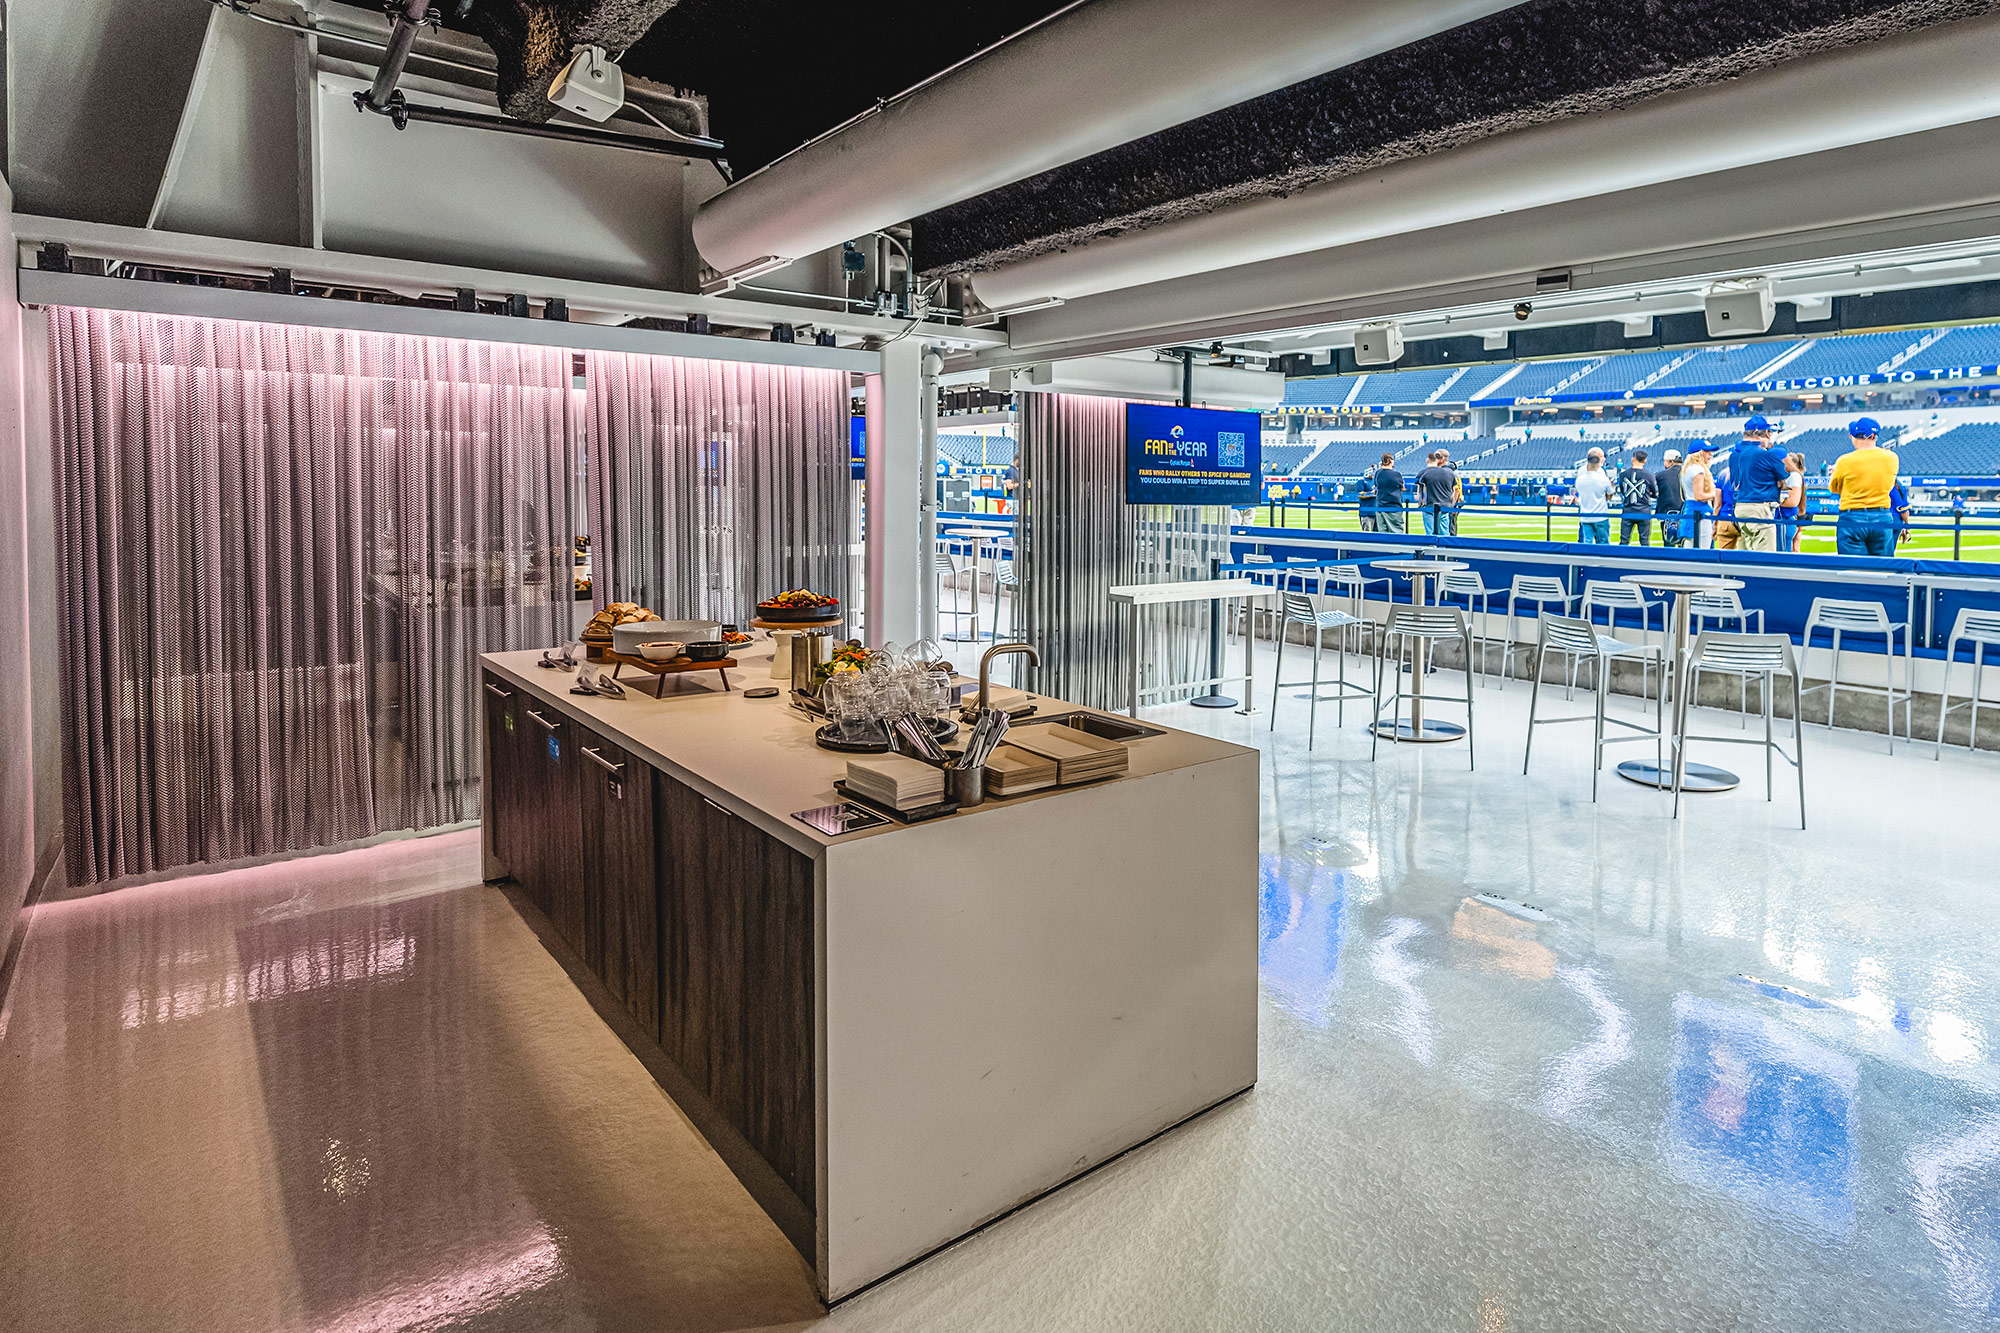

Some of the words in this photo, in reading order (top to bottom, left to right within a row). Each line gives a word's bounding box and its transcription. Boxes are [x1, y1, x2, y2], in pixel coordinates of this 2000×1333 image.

[1756, 374, 1871, 392] WELCOME
[1884, 371, 1916, 383] TO
[1930, 366, 1983, 380] THE
[1331, 406, 1371, 414] TOUR
[1145, 439, 1168, 455] FAN
[1176, 441, 1207, 457] YEAR
